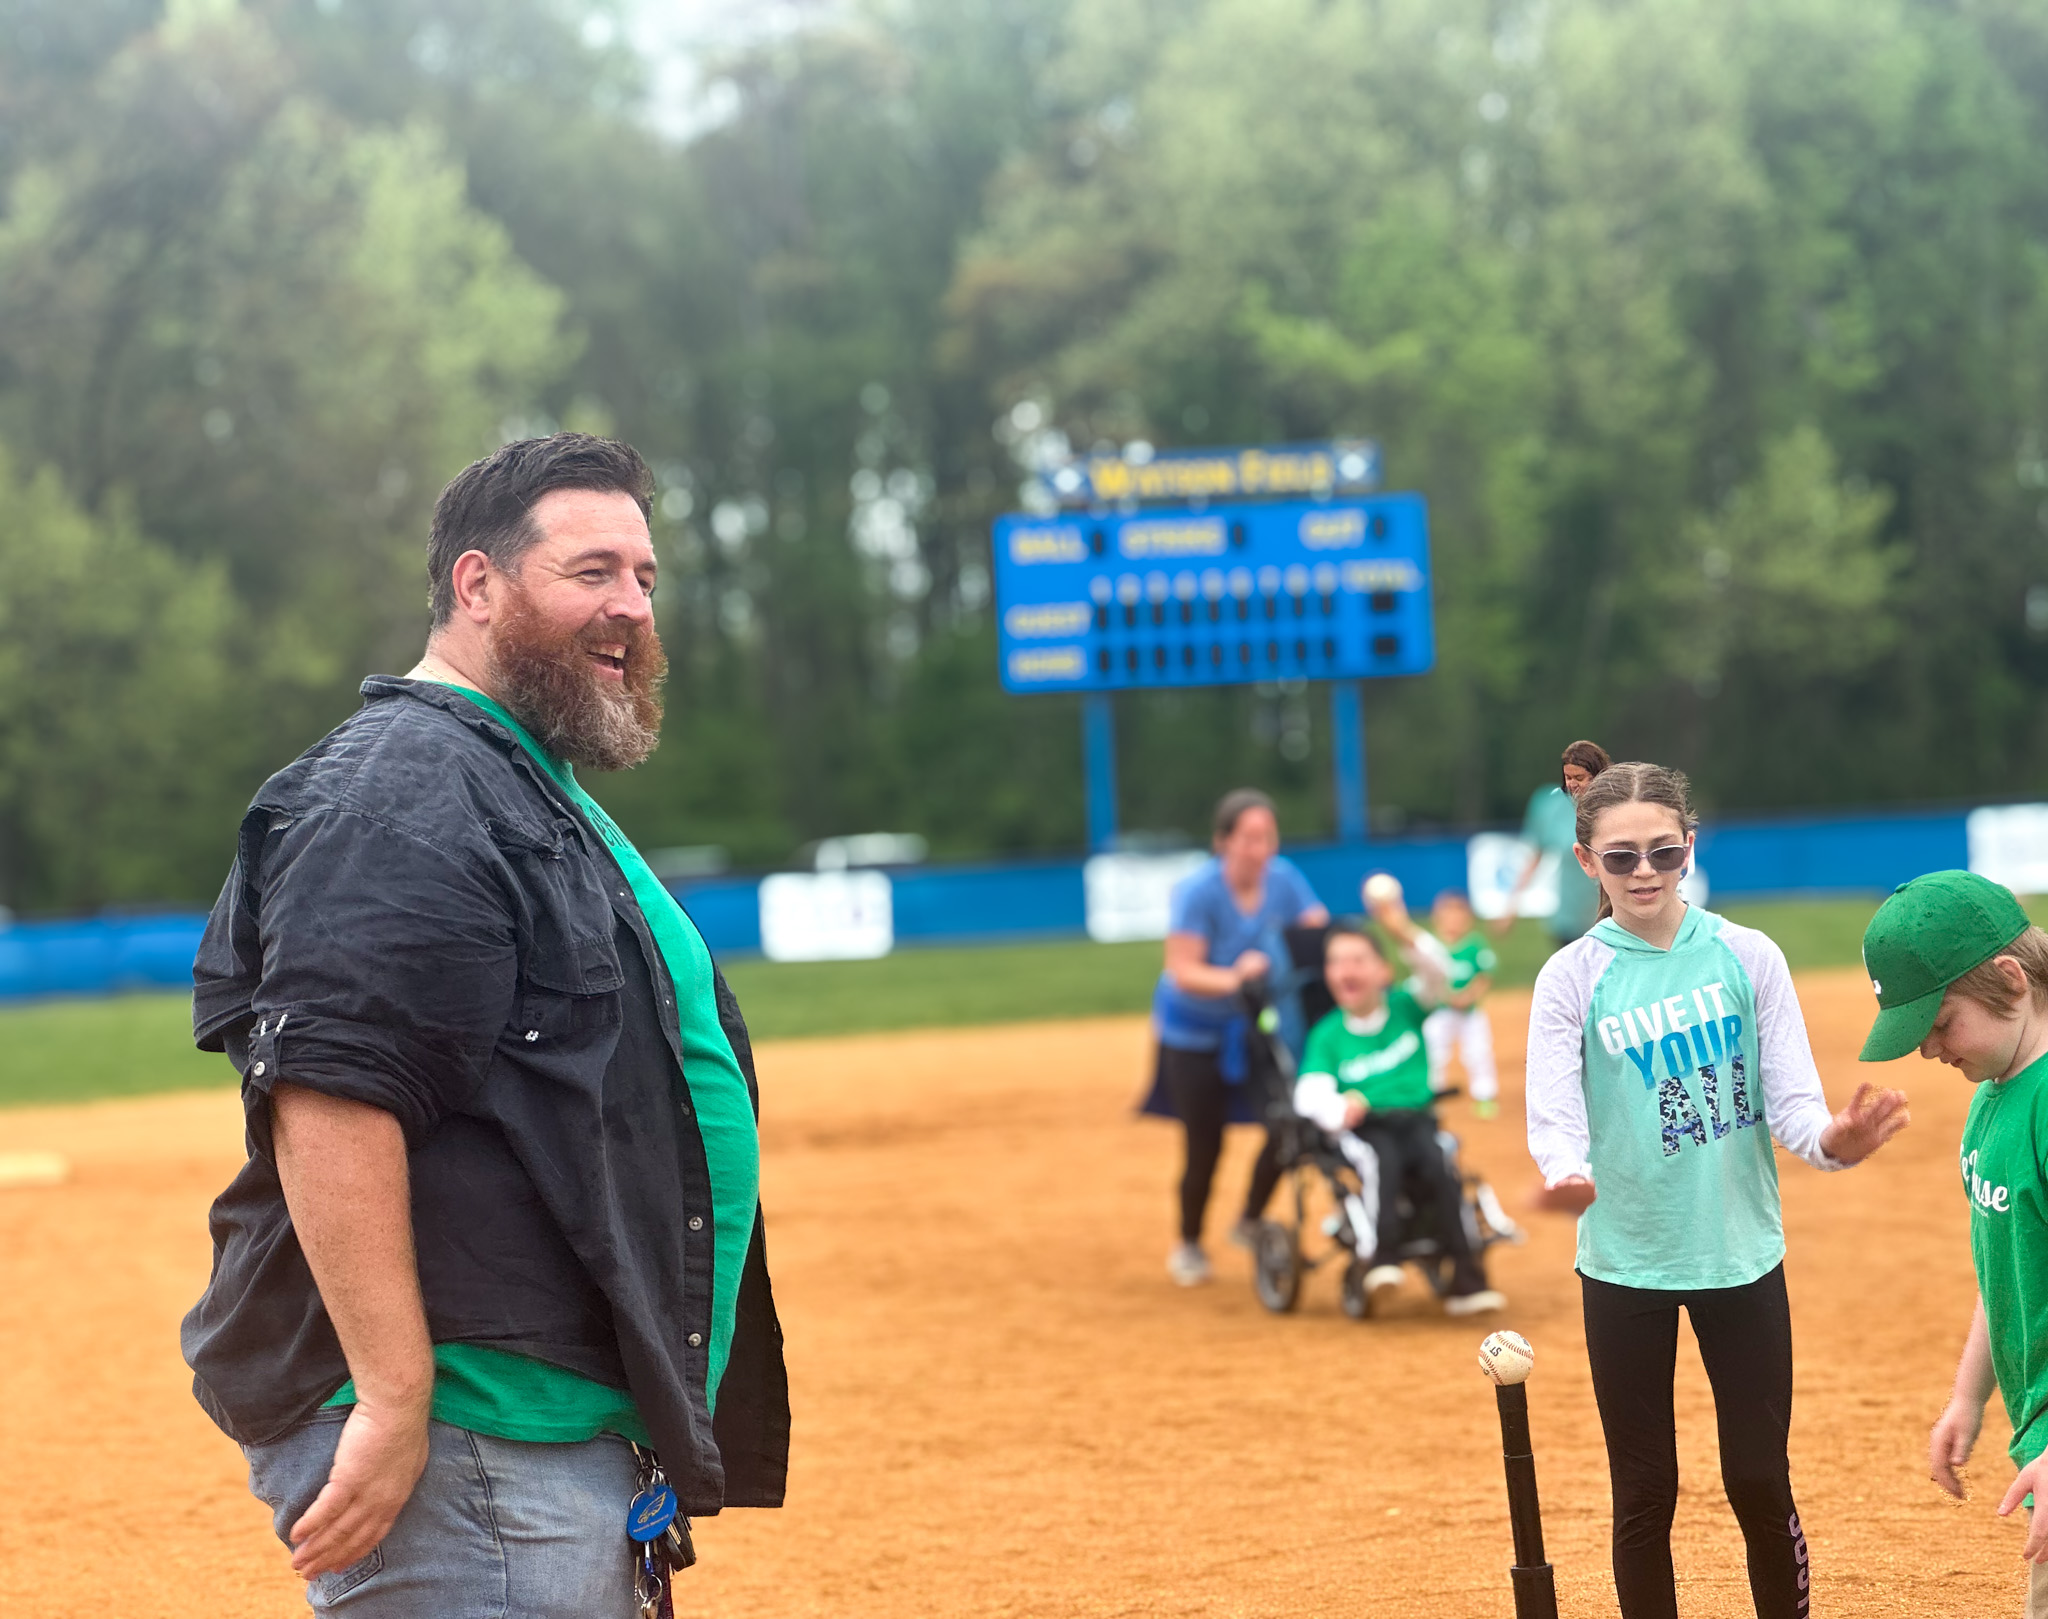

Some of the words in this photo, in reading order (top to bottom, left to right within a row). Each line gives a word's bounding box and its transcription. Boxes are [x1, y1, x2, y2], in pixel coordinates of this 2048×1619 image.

[1598, 994, 1692, 1056] GIVE
[1692, 982, 1728, 1027] IT
[1624, 1014, 1742, 1091] YOUR
[1658, 1054, 1761, 1157] ALL
